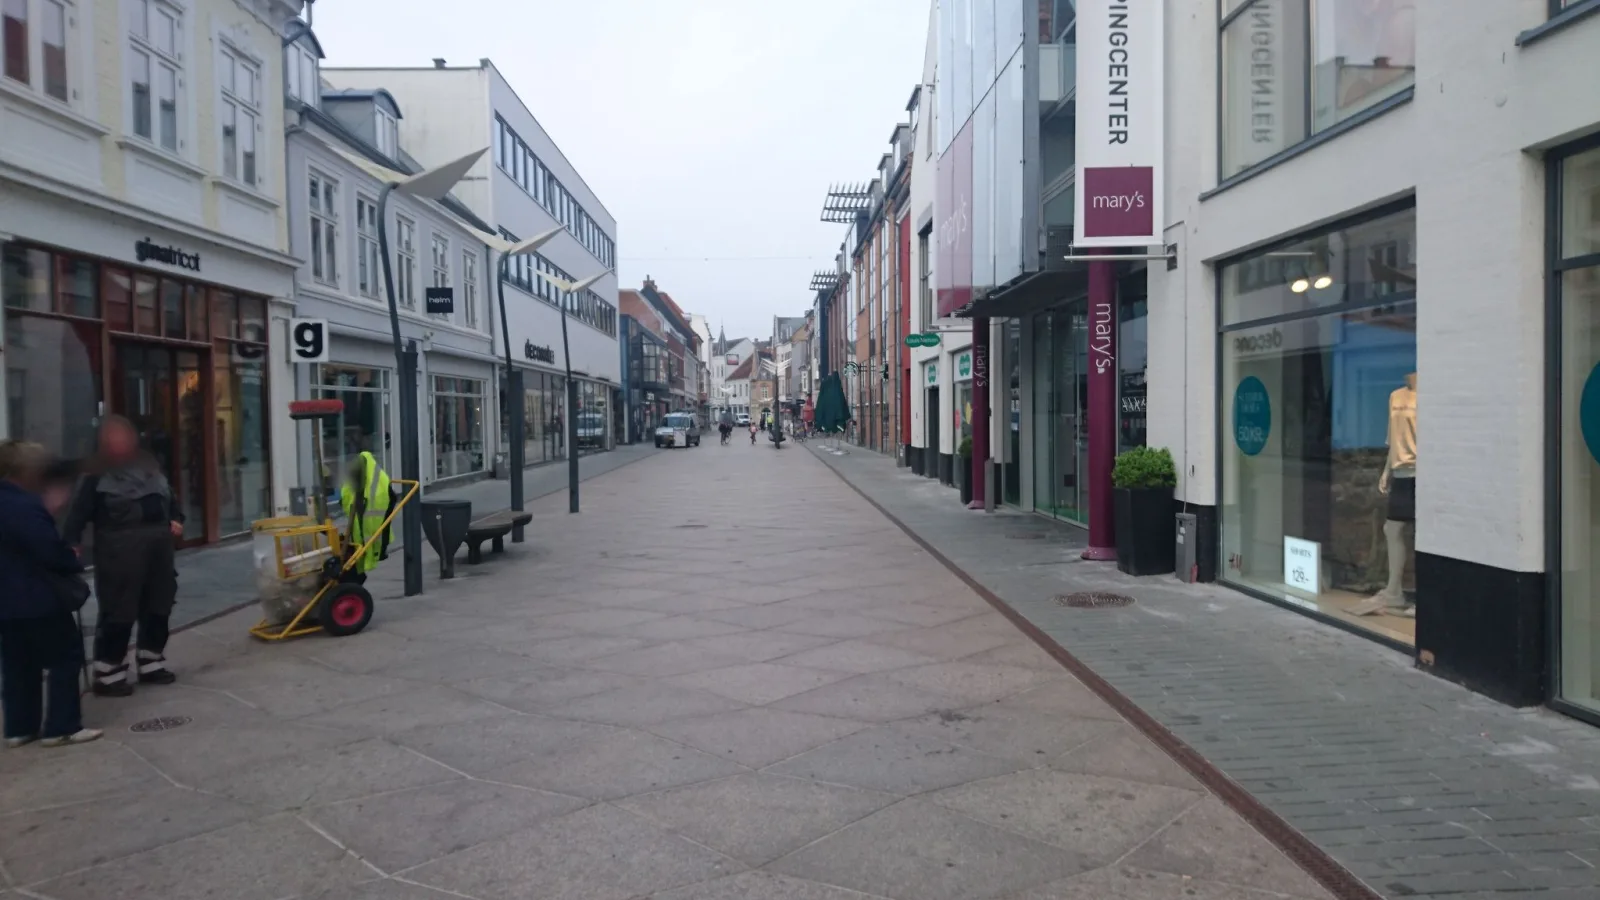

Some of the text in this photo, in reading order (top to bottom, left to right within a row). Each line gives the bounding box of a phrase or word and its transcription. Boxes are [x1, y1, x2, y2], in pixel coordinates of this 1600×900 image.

[1109, 0, 1128, 145] INGCENTER
[1092, 191, 1145, 212] mary's
[294, 322, 323, 358] g
[1091, 303, 1114, 368] mary's
